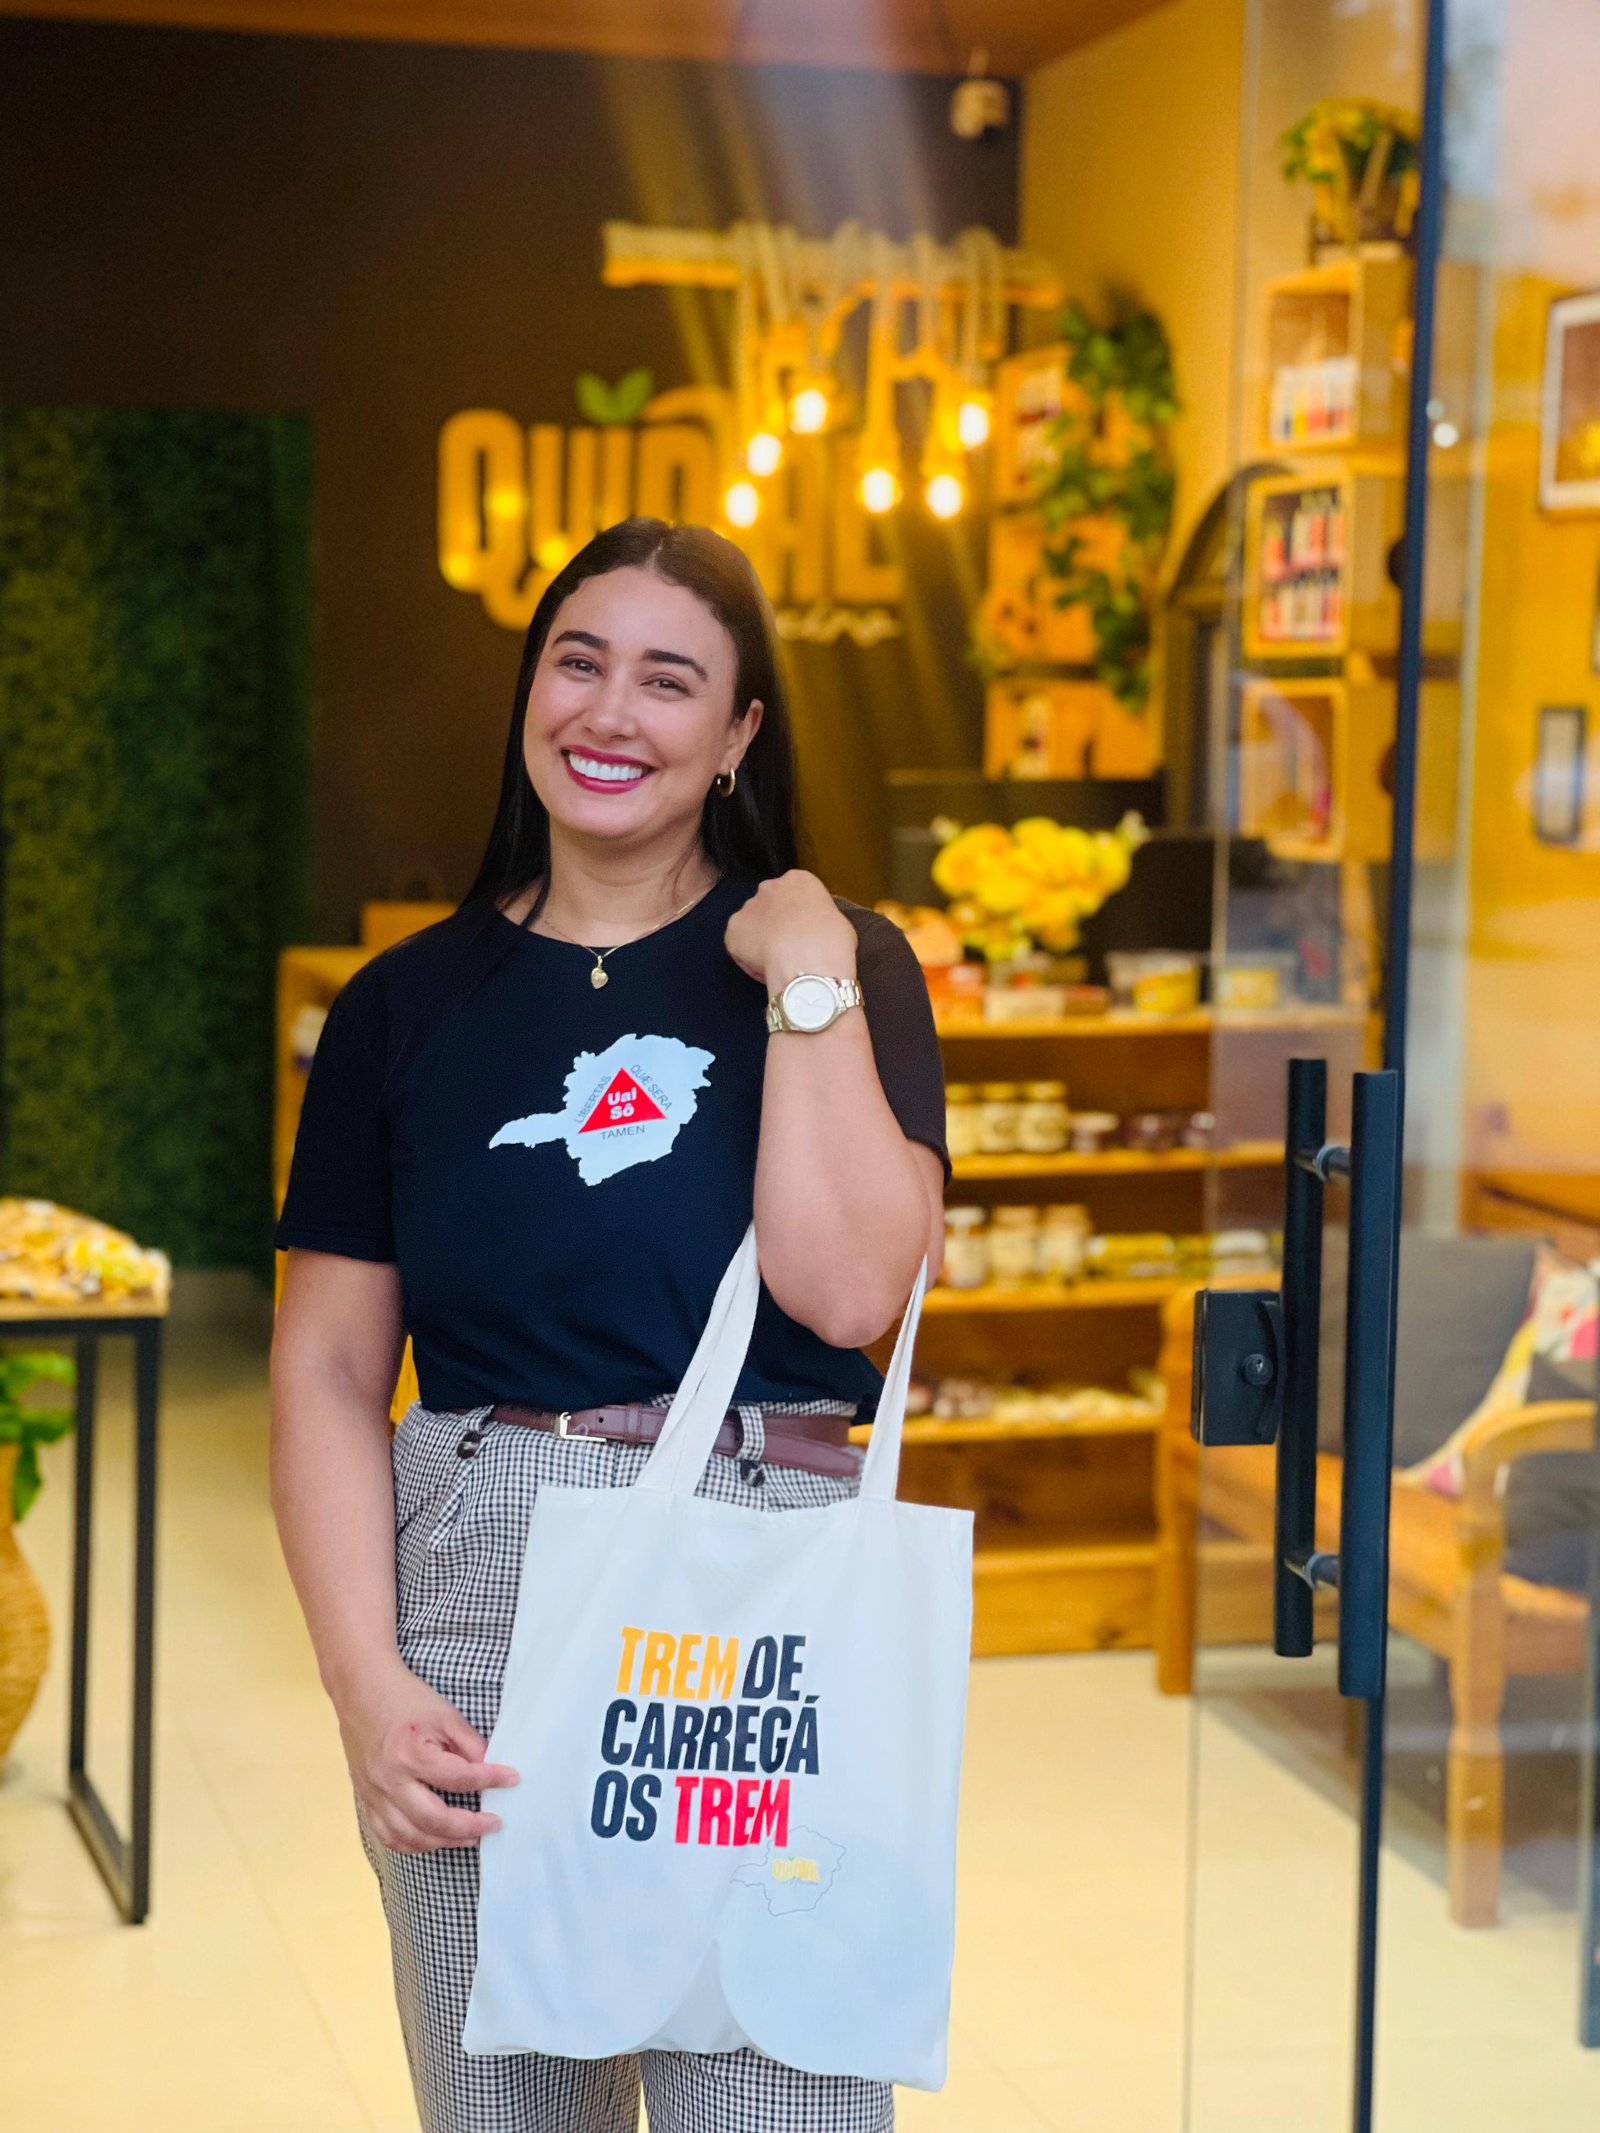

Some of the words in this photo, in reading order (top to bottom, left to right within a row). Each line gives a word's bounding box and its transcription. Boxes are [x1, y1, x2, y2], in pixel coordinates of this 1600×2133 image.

[575, 1075, 613, 1124] LIBERTAS
[647, 1083, 673, 1111] SERA
[600, 1124, 646, 1141] TAMEN
[616, 1626, 739, 1700] TREM
[741, 1634, 807, 1701] DE
[601, 1694, 821, 1775] CARREGÁ
[590, 1770, 662, 1842] OS
[674, 1775, 791, 1849] TREM
